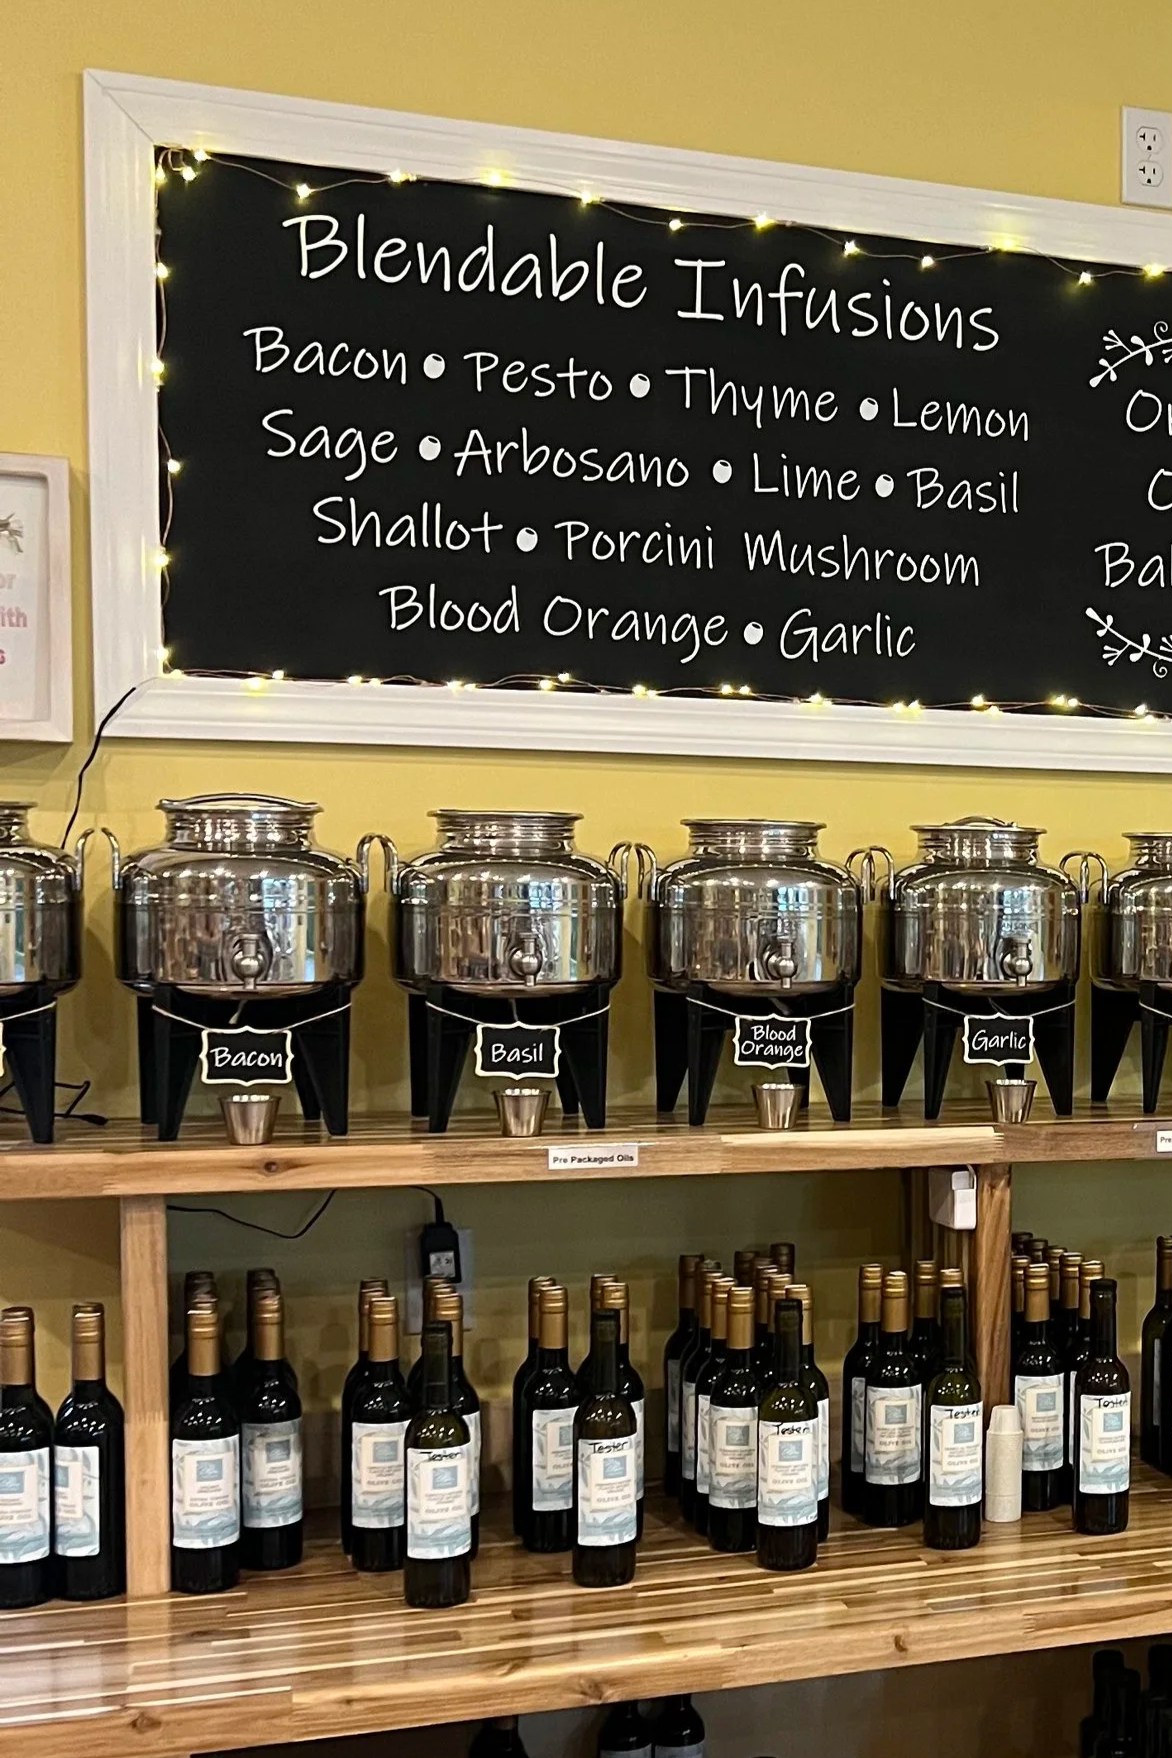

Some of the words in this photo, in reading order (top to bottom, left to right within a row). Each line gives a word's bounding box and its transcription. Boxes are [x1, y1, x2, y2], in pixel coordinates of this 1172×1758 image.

[282, 214, 647, 308] Blendable
[675, 256, 998, 351] Infusions
[243, 327, 406, 384] Bacon
[464, 352, 612, 400] Pesto
[665, 367, 838, 428] Thyme
[893, 388, 1028, 441] Lemon
[262, 409, 397, 481] Sage
[454, 427, 689, 487] Arbosano
[754, 453, 860, 500] Lime
[907, 468, 1018, 513] Basil
[313, 497, 503, 553] Shallot
[555, 521, 713, 569] Porcini
[745, 530, 978, 586] Mushroom
[379, 584, 519, 633] Blood
[544, 596, 728, 663] Orange
[780, 609, 915, 662] Garlic
[751, 1025, 796, 1041] Blood
[971, 1030, 1026, 1052] Garlic
[210, 1046, 284, 1067] Bacon
[491, 1043, 543, 1064] Basil
[741, 1040, 804, 1062] Orange
[553, 1156, 568, 1164] Pre
[570, 1155, 615, 1165] Packaged
[617, 1154, 635, 1162] Oils
[588, 1441, 627, 1453] Tester
